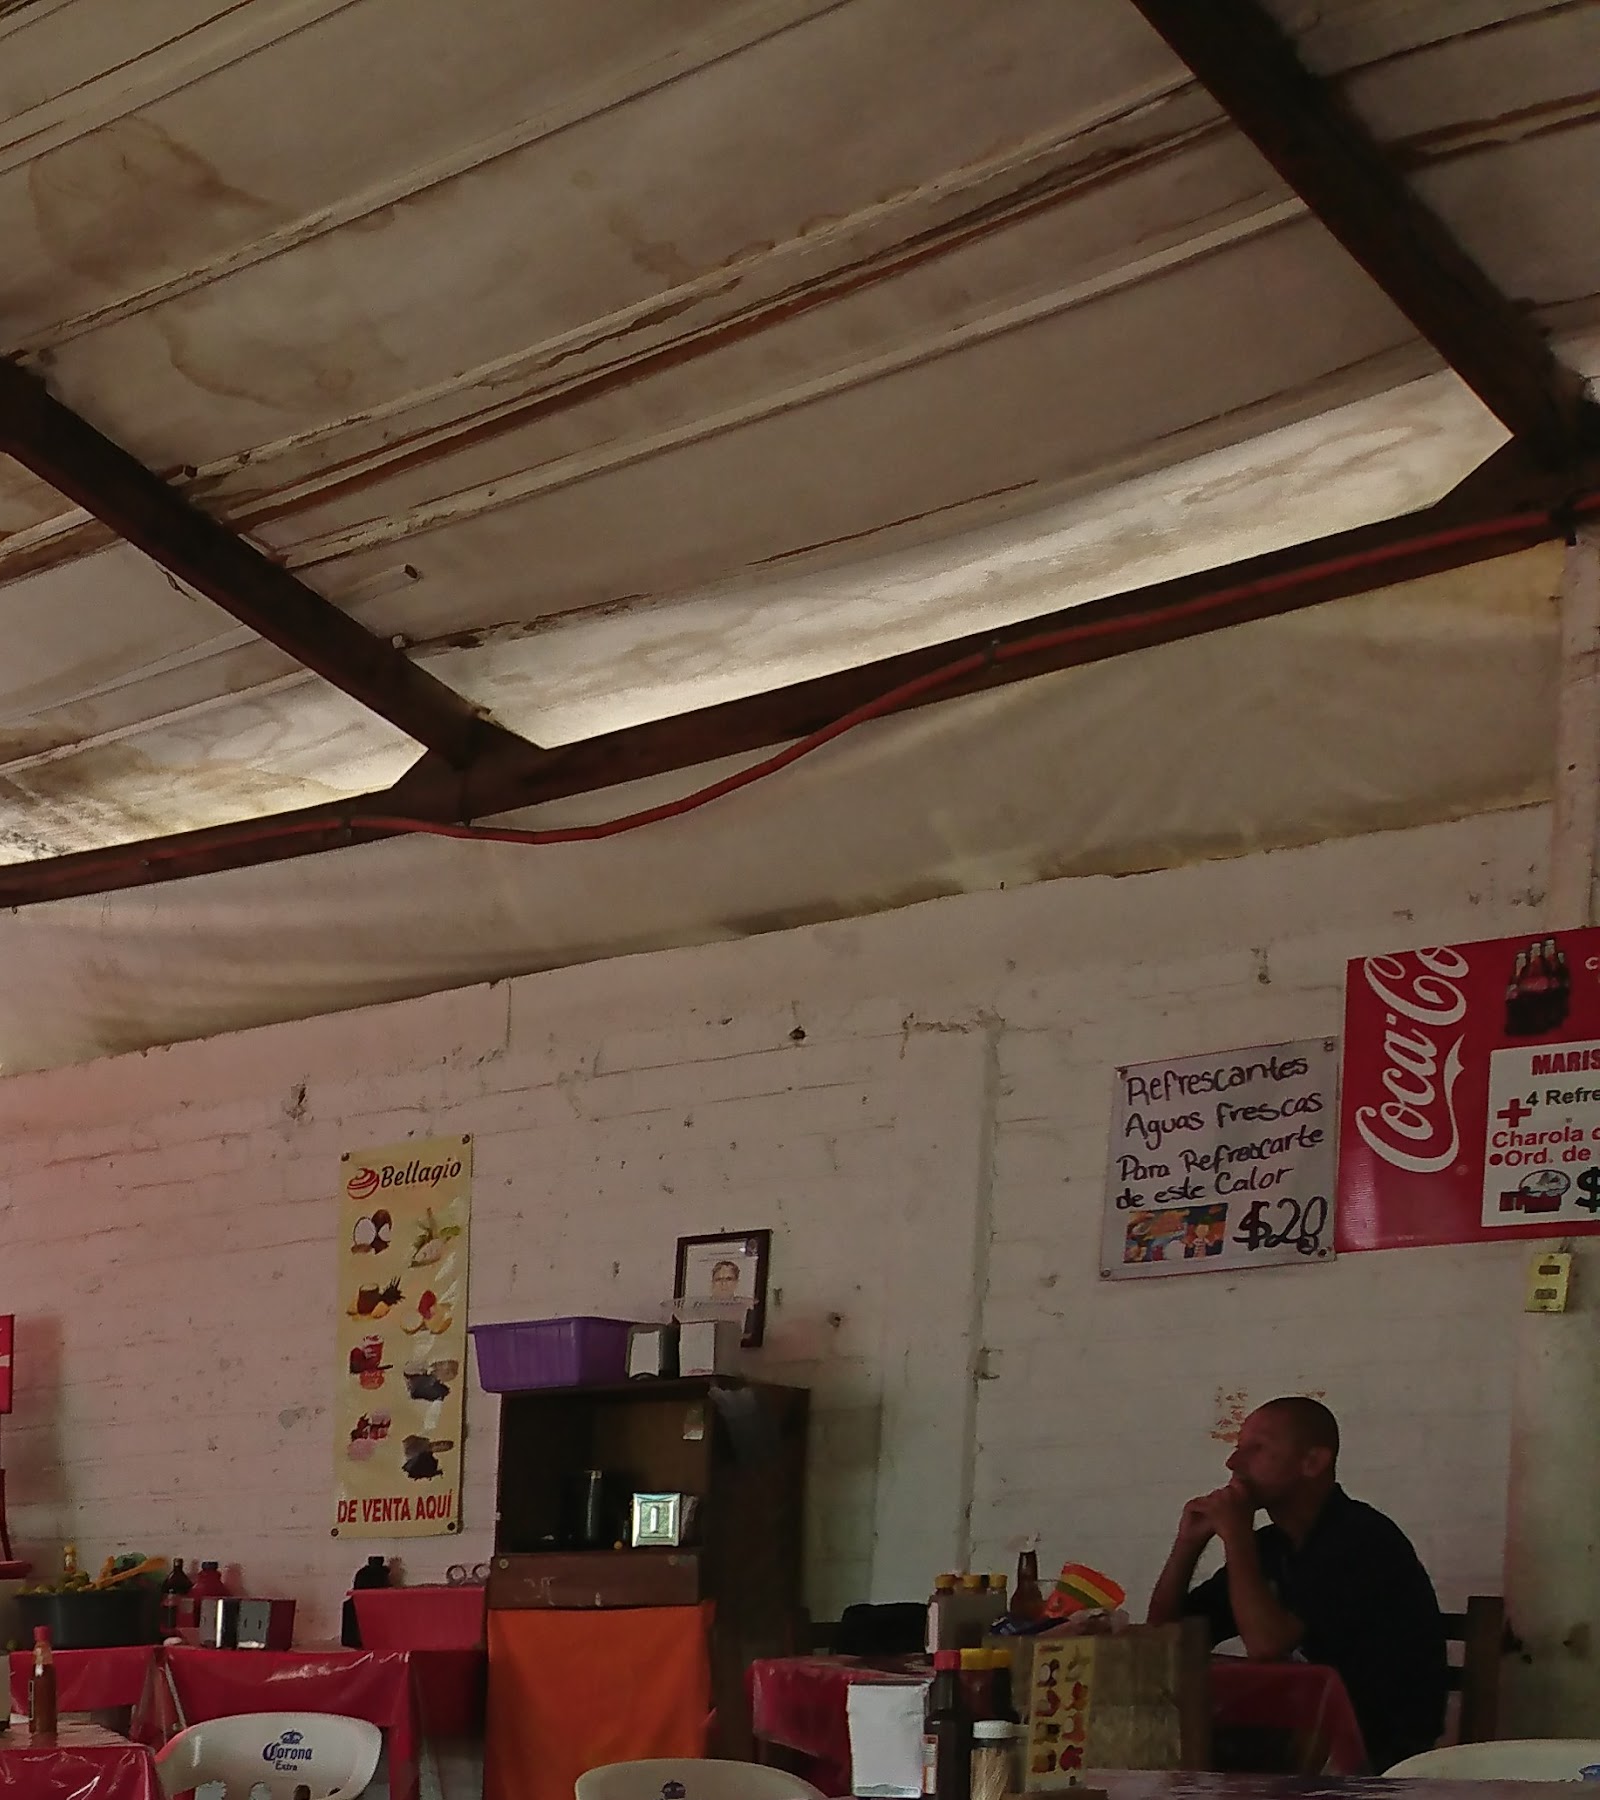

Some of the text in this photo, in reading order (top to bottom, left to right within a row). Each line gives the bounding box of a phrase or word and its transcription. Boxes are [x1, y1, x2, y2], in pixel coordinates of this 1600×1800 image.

[1127, 1056, 1308, 1105] Refrescantes
[1526, 1091, 1539, 1106] 4
[1125, 1112, 1204, 1150] Aguas
[1492, 1126, 1584, 1148] Charola
[1116, 1154, 1171, 1181] Para
[1562, 1145, 1591, 1162] de
[381, 1157, 461, 1188] Bellagio
[1116, 1166, 1294, 1209] de este Calor
[337, 1488, 452, 1523] DE VENTA AQUÍ
[262, 1742, 313, 1761] Corona
